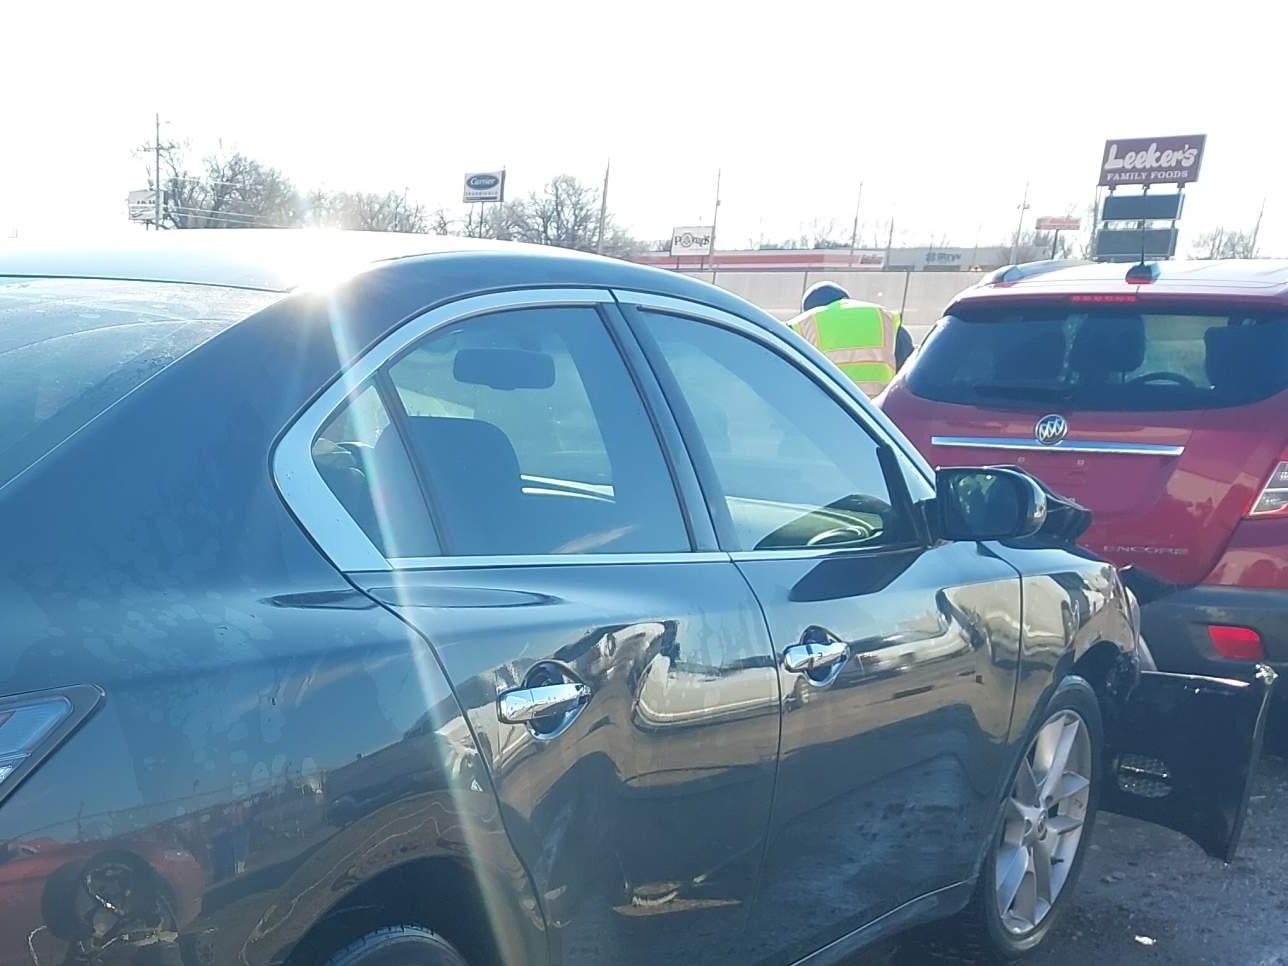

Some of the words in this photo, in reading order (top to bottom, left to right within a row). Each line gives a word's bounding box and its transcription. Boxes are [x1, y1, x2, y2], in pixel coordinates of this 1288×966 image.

[1104, 142, 1198, 169] Leeker's
[1107, 172, 1148, 181] FAMILY
[1150, 170, 1188, 179] FOODS
[1103, 545, 1189, 555] ENCORE
